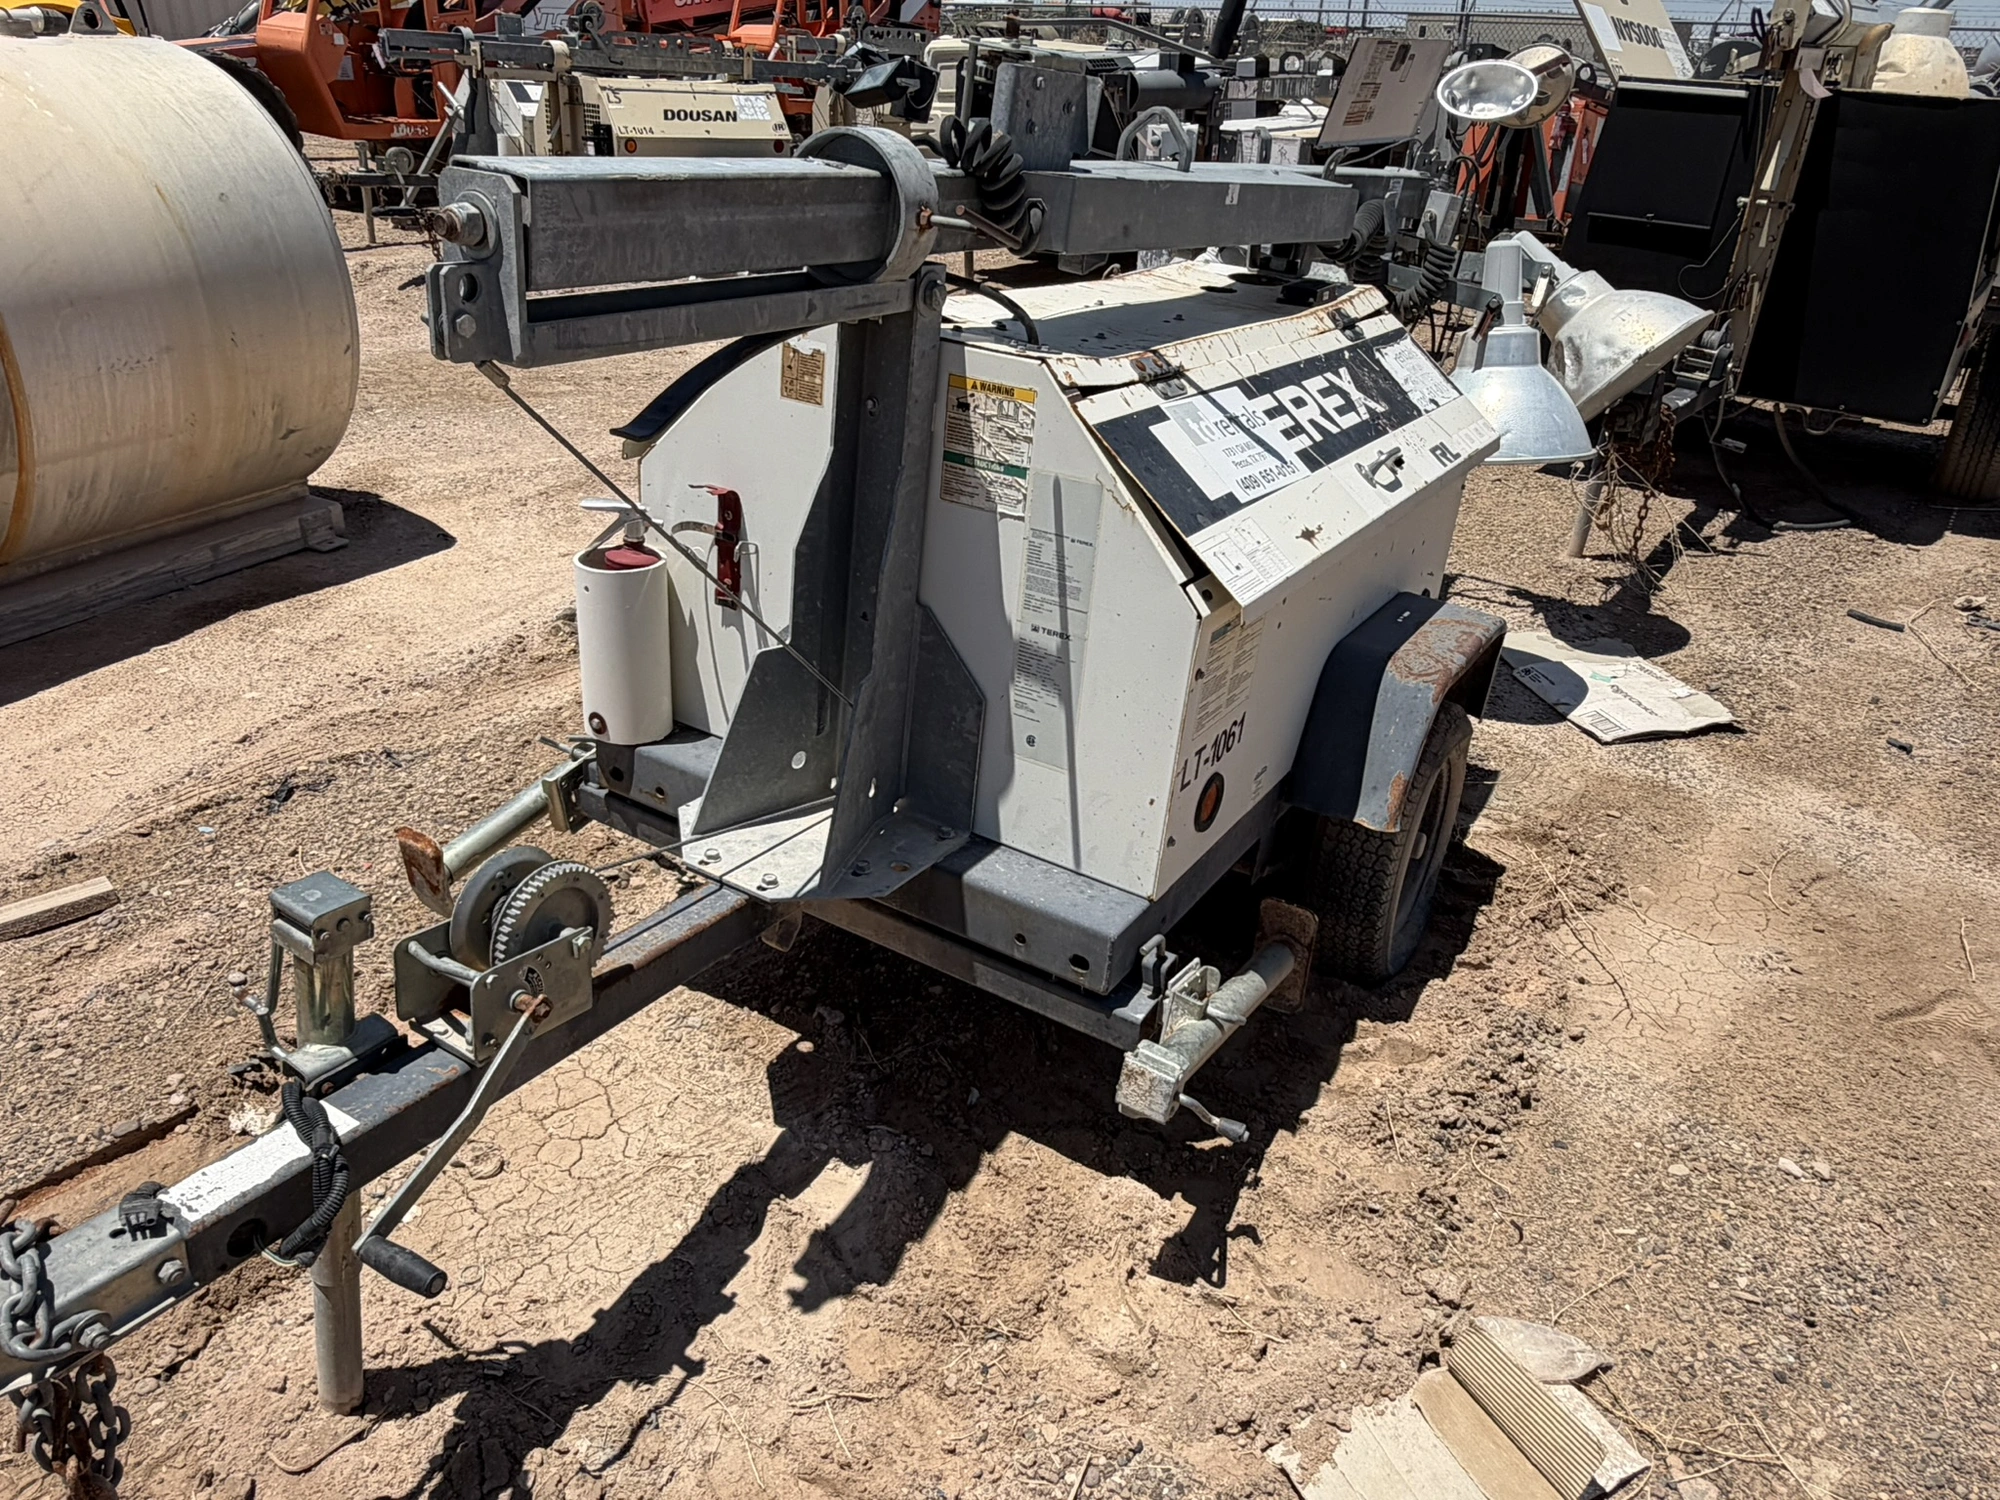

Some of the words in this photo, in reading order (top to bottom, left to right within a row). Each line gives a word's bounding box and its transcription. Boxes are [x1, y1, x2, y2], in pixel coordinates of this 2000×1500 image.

[979, 381, 1015, 397] WARNING
[1249, 367, 1387, 452] EREX
[1429, 442, 1462, 467] RL
[1235, 473, 1266, 496] (409)
[1041, 627, 1071, 641] TEREX
[1180, 711, 1247, 793] LT-1061
